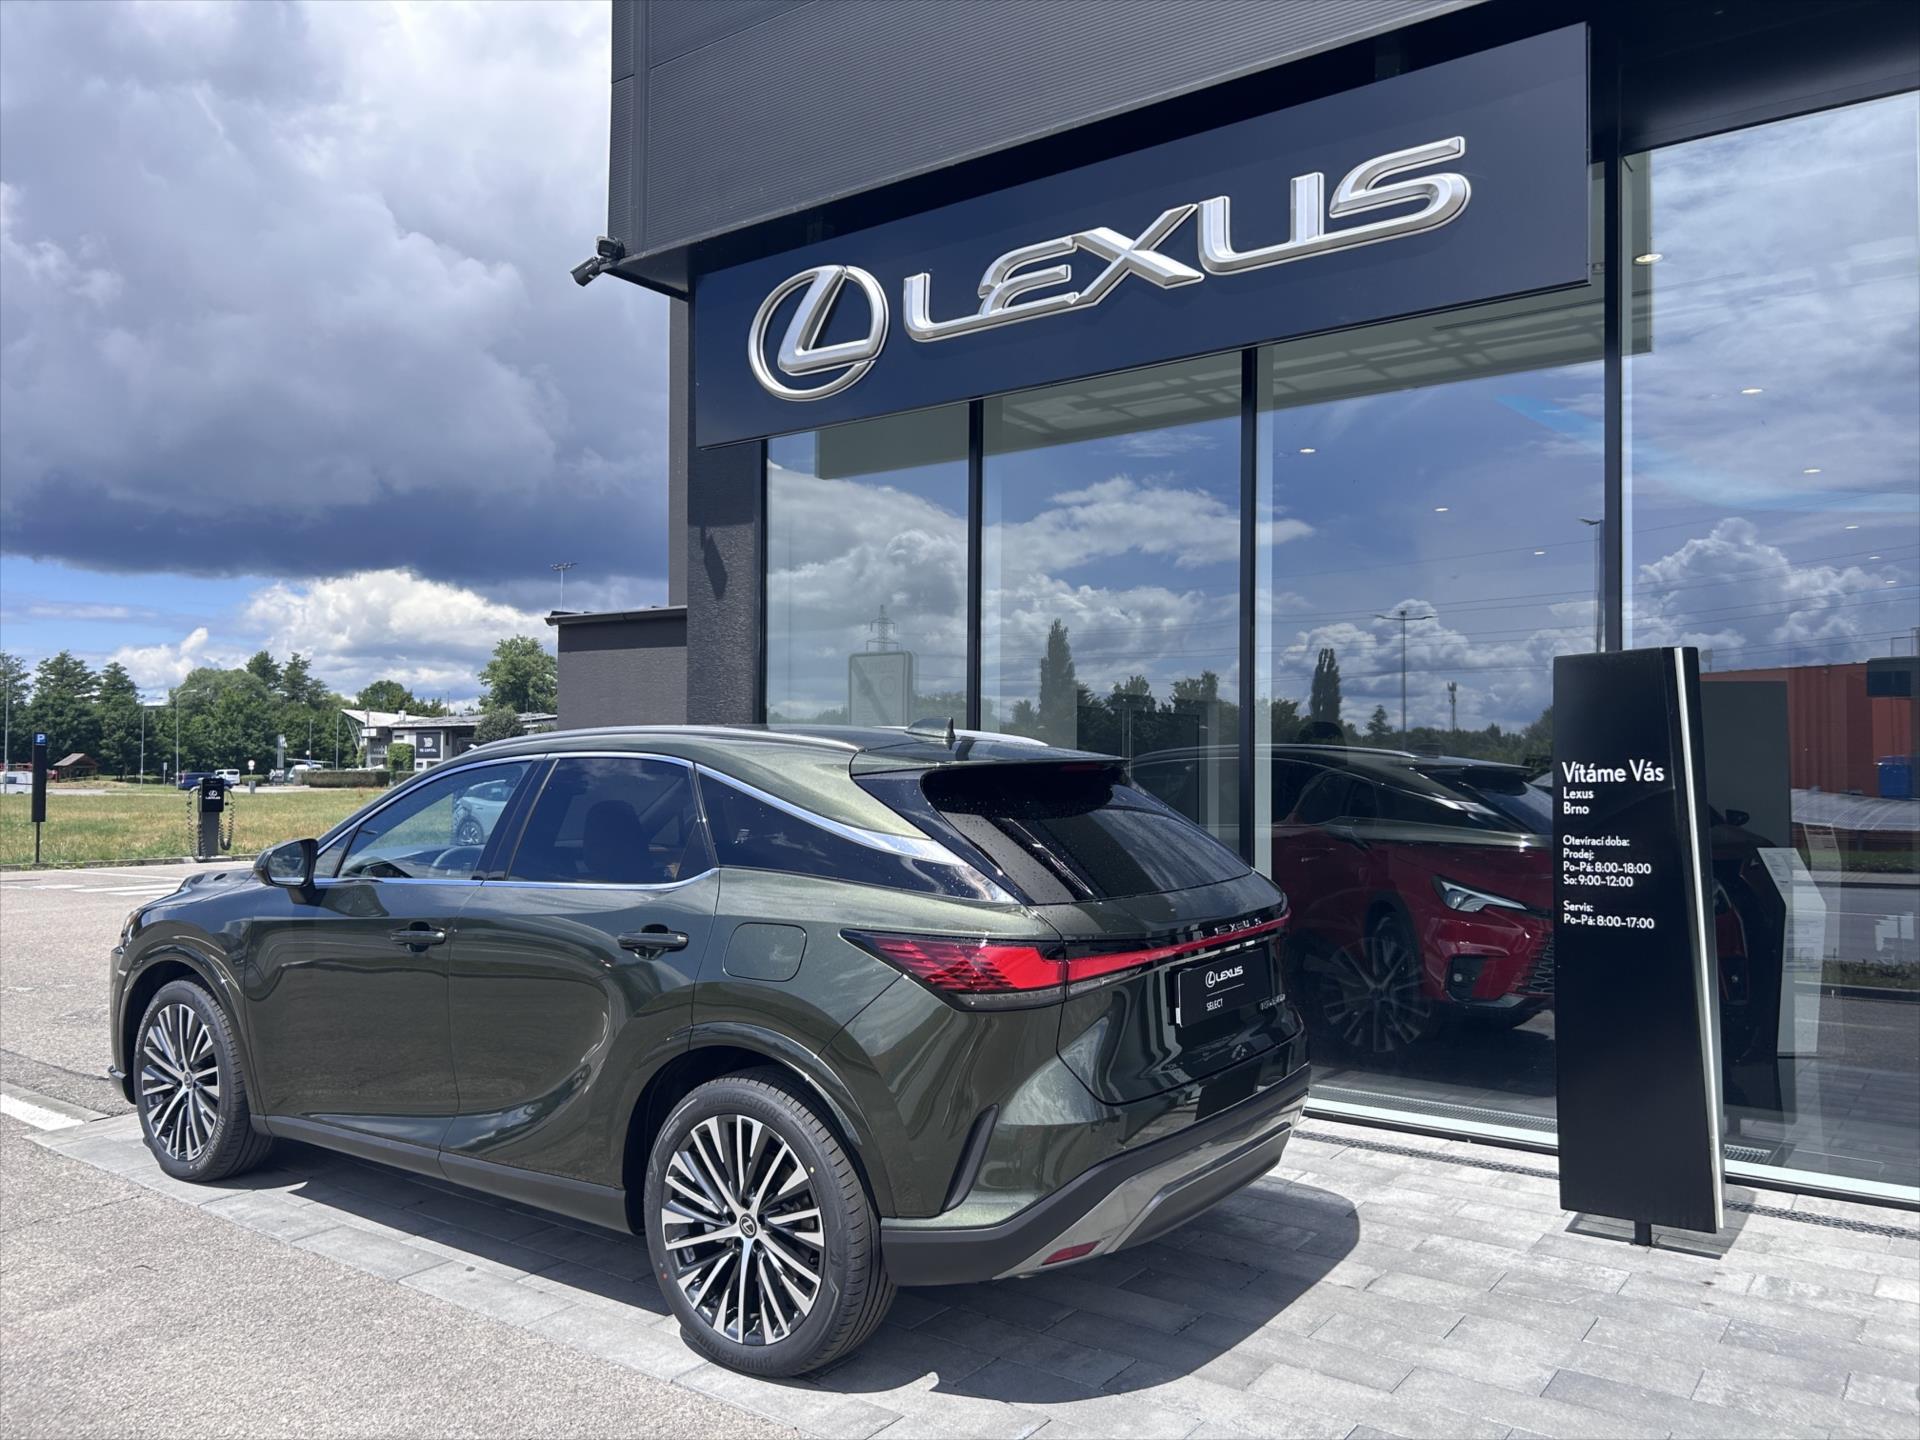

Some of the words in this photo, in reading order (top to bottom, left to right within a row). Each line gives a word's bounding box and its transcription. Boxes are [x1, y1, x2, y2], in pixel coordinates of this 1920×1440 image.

[904, 136, 1471, 342] LEXUS
[1562, 761, 1626, 783] Vítáme
[1629, 759, 1664, 781] Vás
[1563, 787, 1594, 799] Lexus
[1563, 802, 1589, 814] Brno
[1563, 834, 1604, 846] Otevírací
[1605, 836, 1630, 846] doba:
[1563, 848, 1594, 859] Prodej:
[1563, 874, 1578, 885] So:
[1563, 900, 1594, 912] Servis:
[1216, 966, 1244, 982] LEXUS
[1206, 998, 1223, 1012] SELECT
